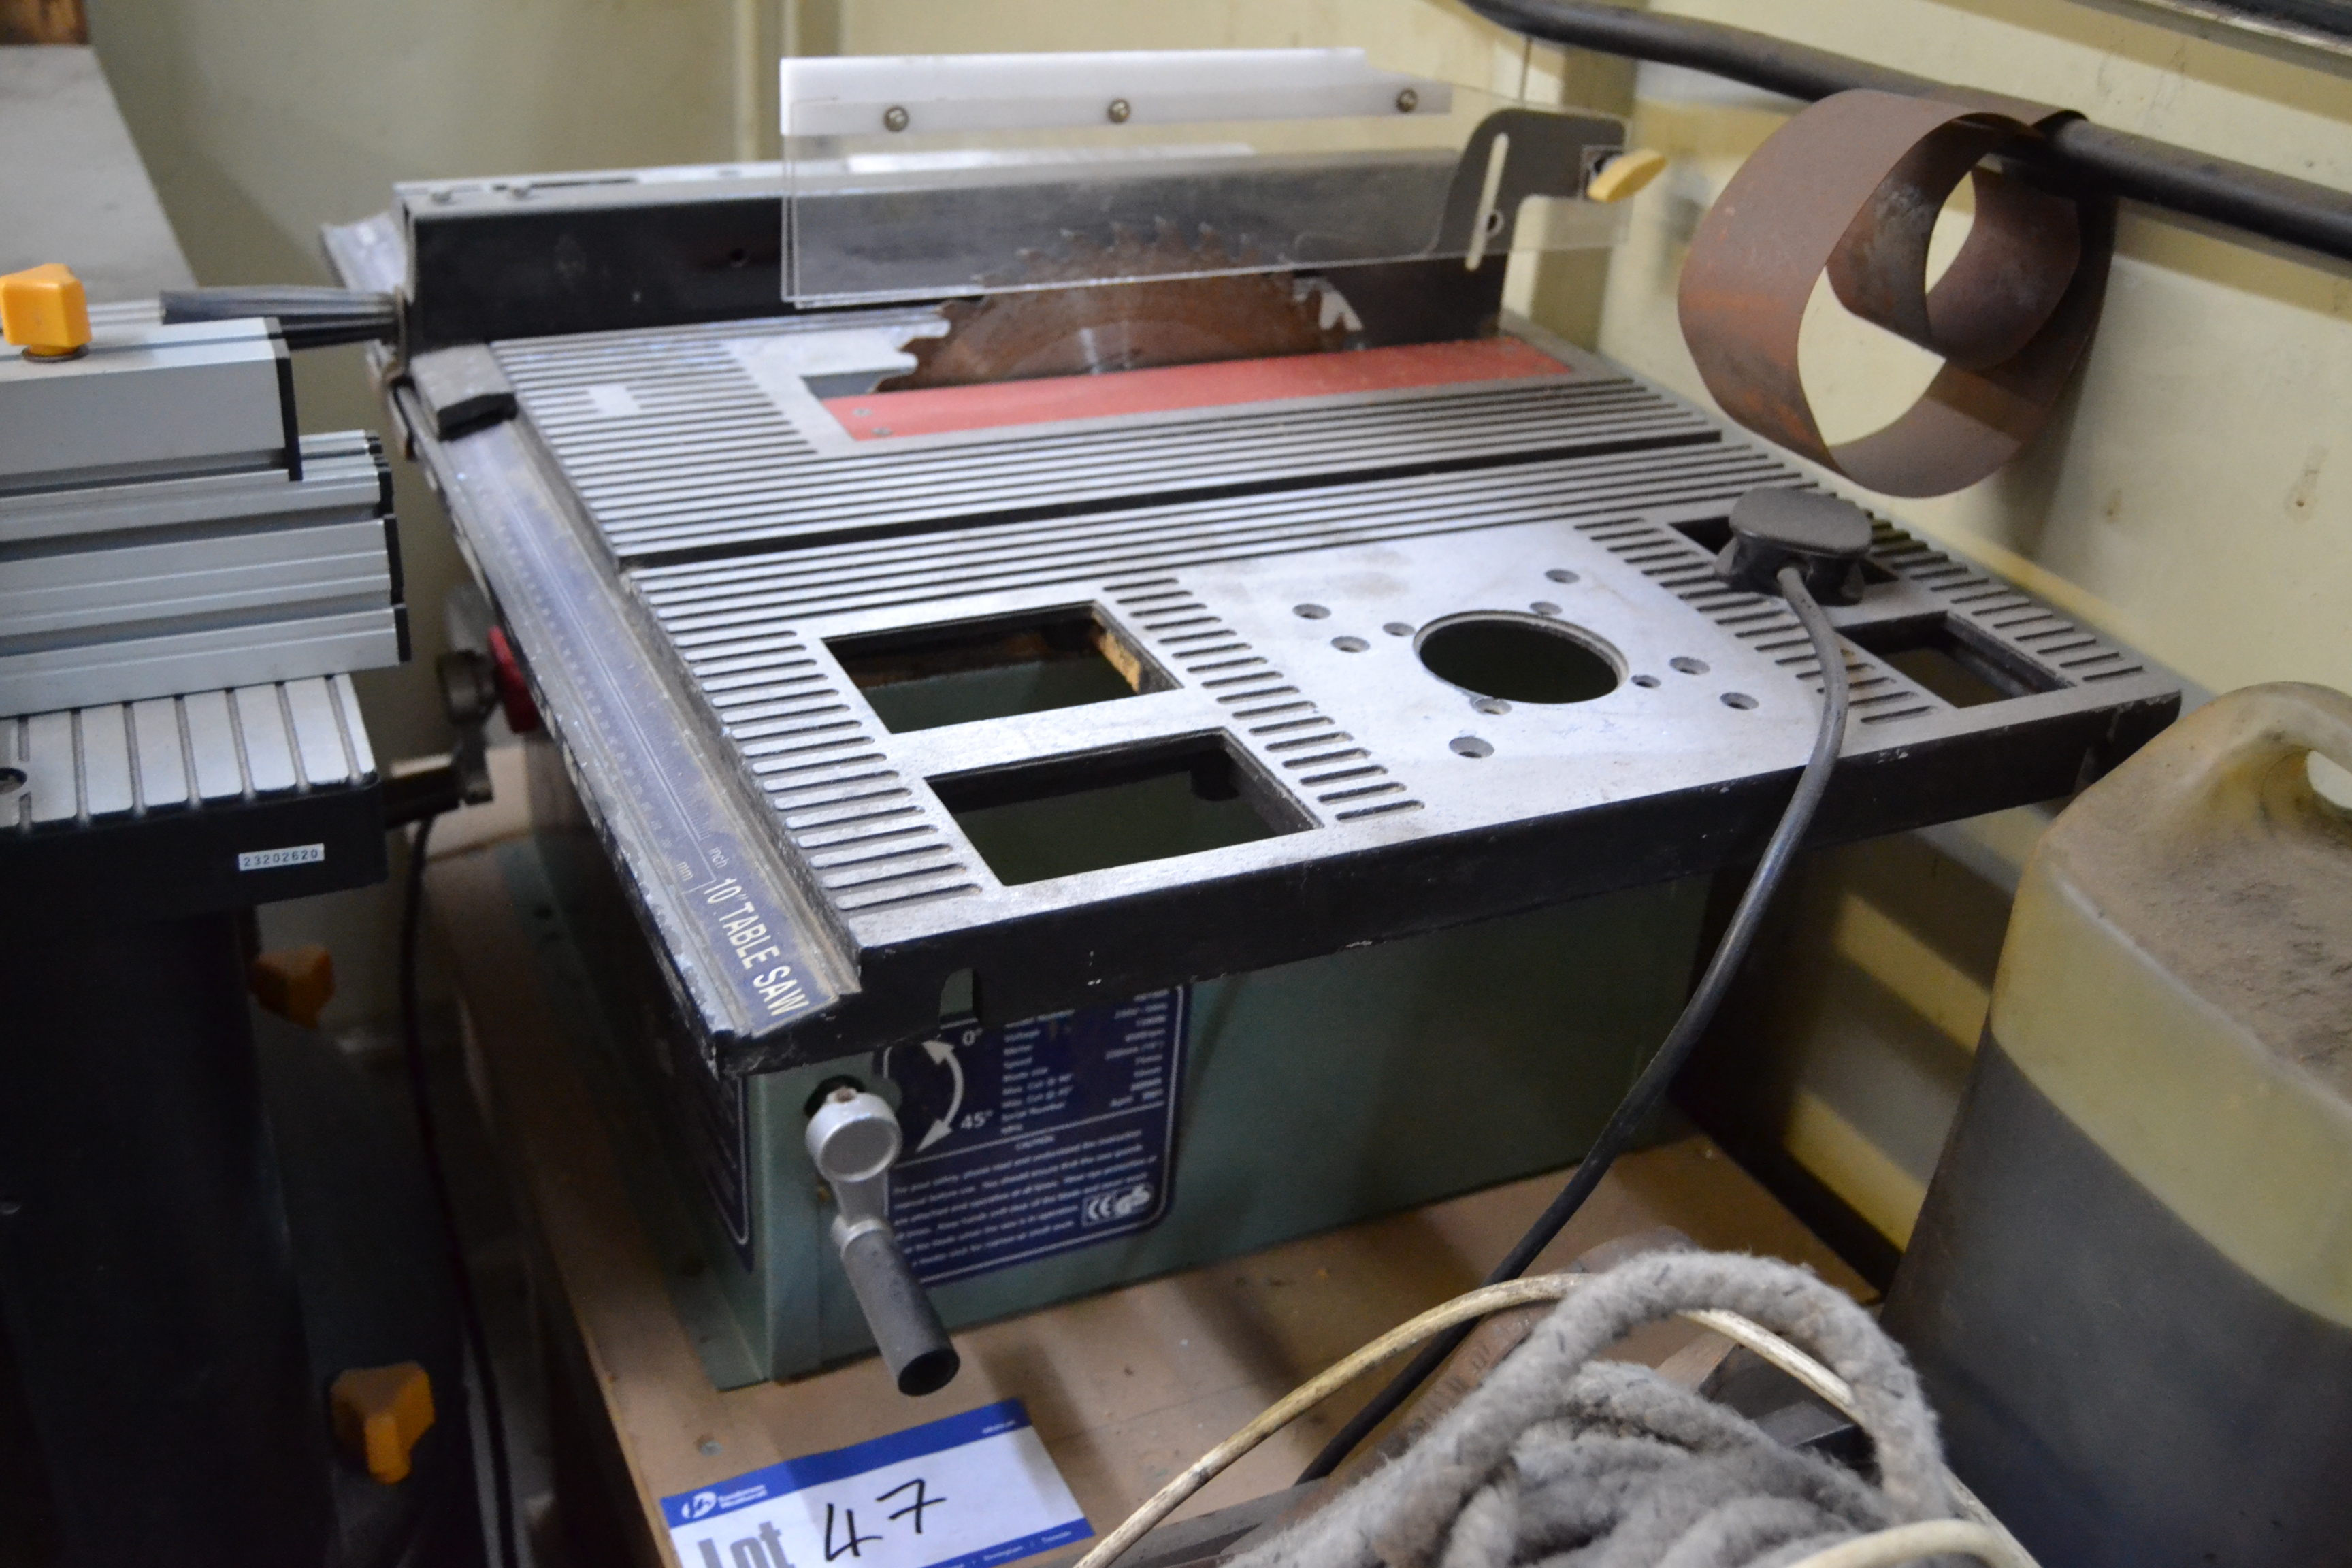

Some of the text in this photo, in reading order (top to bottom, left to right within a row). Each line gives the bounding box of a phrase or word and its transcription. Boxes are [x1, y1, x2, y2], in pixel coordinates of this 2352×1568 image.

[244, 849, 318, 867] 23202620
[709, 846, 728, 869] inch
[676, 861, 693, 881] mm
[719, 901, 781, 970] TABLE
[753, 965, 810, 1017] SAW
[825, 1477, 947, 1563] 47
